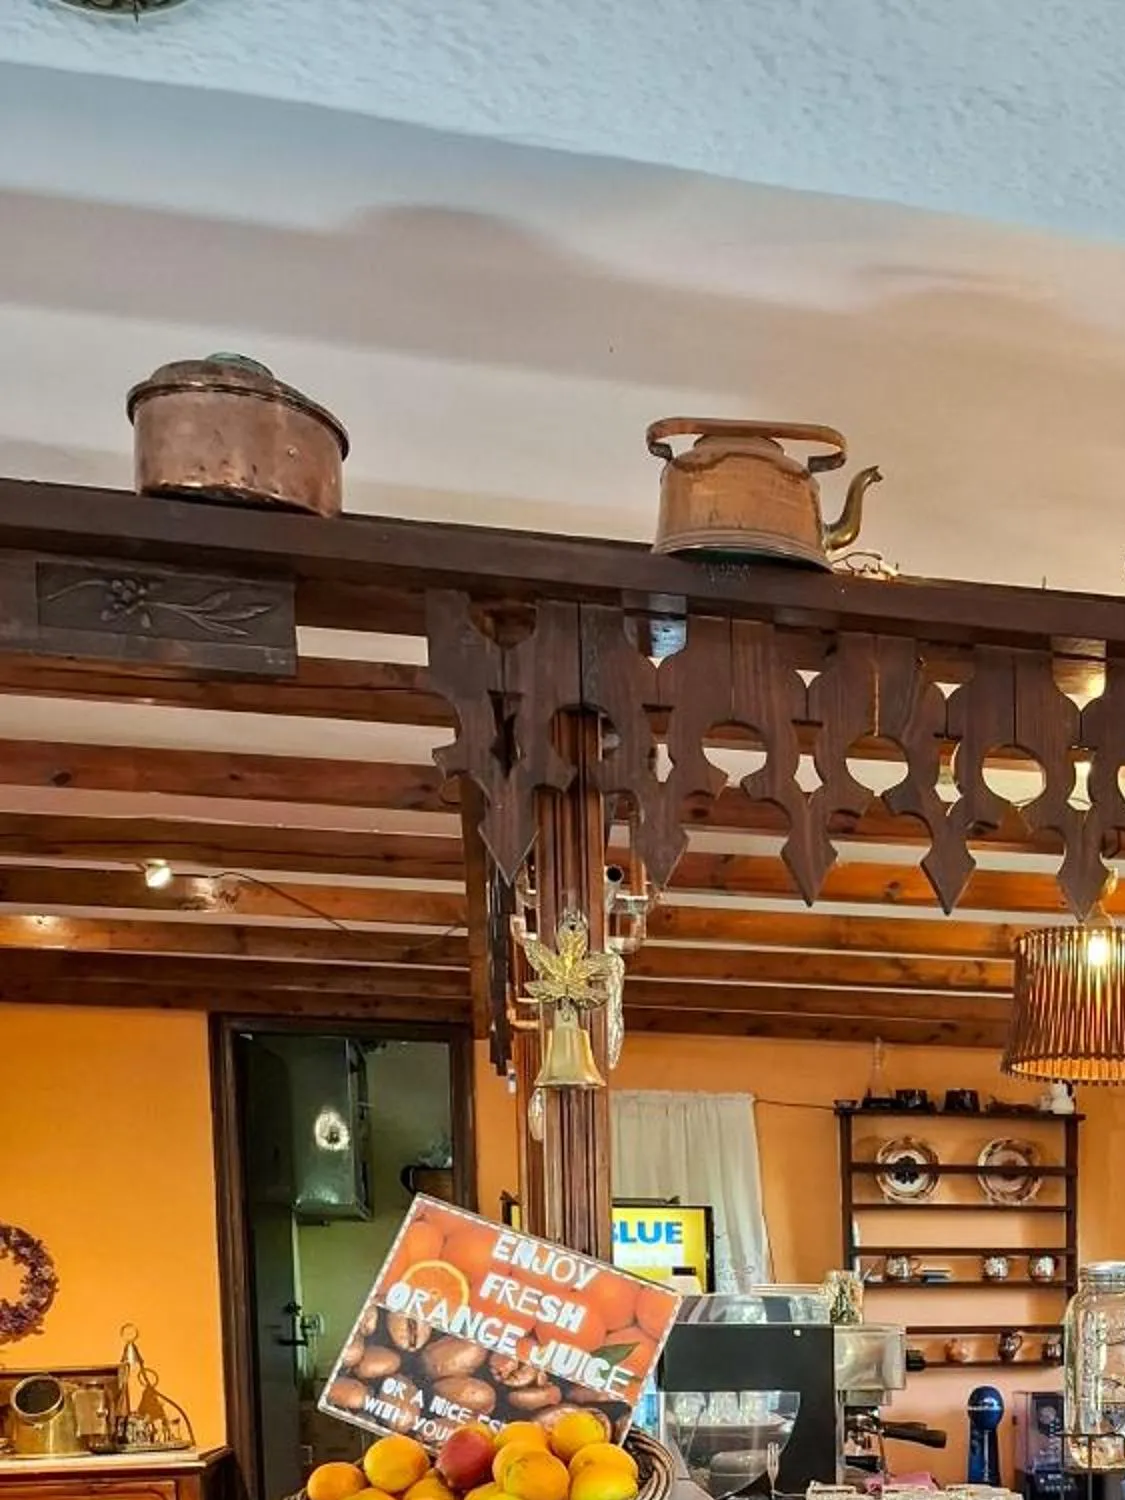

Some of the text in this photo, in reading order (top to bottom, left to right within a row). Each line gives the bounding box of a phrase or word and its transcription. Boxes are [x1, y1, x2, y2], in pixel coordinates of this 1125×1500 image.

[492, 1232, 599, 1290] ENJOY
[479, 1272, 589, 1335] FRESH
[385, 1280, 636, 1401] ORANGE JUICE
[363, 1395, 411, 1427] WITH
[381, 1377, 407, 1400] OR
[409, 1389, 425, 1409] A
[429, 1395, 473, 1425] NICE
